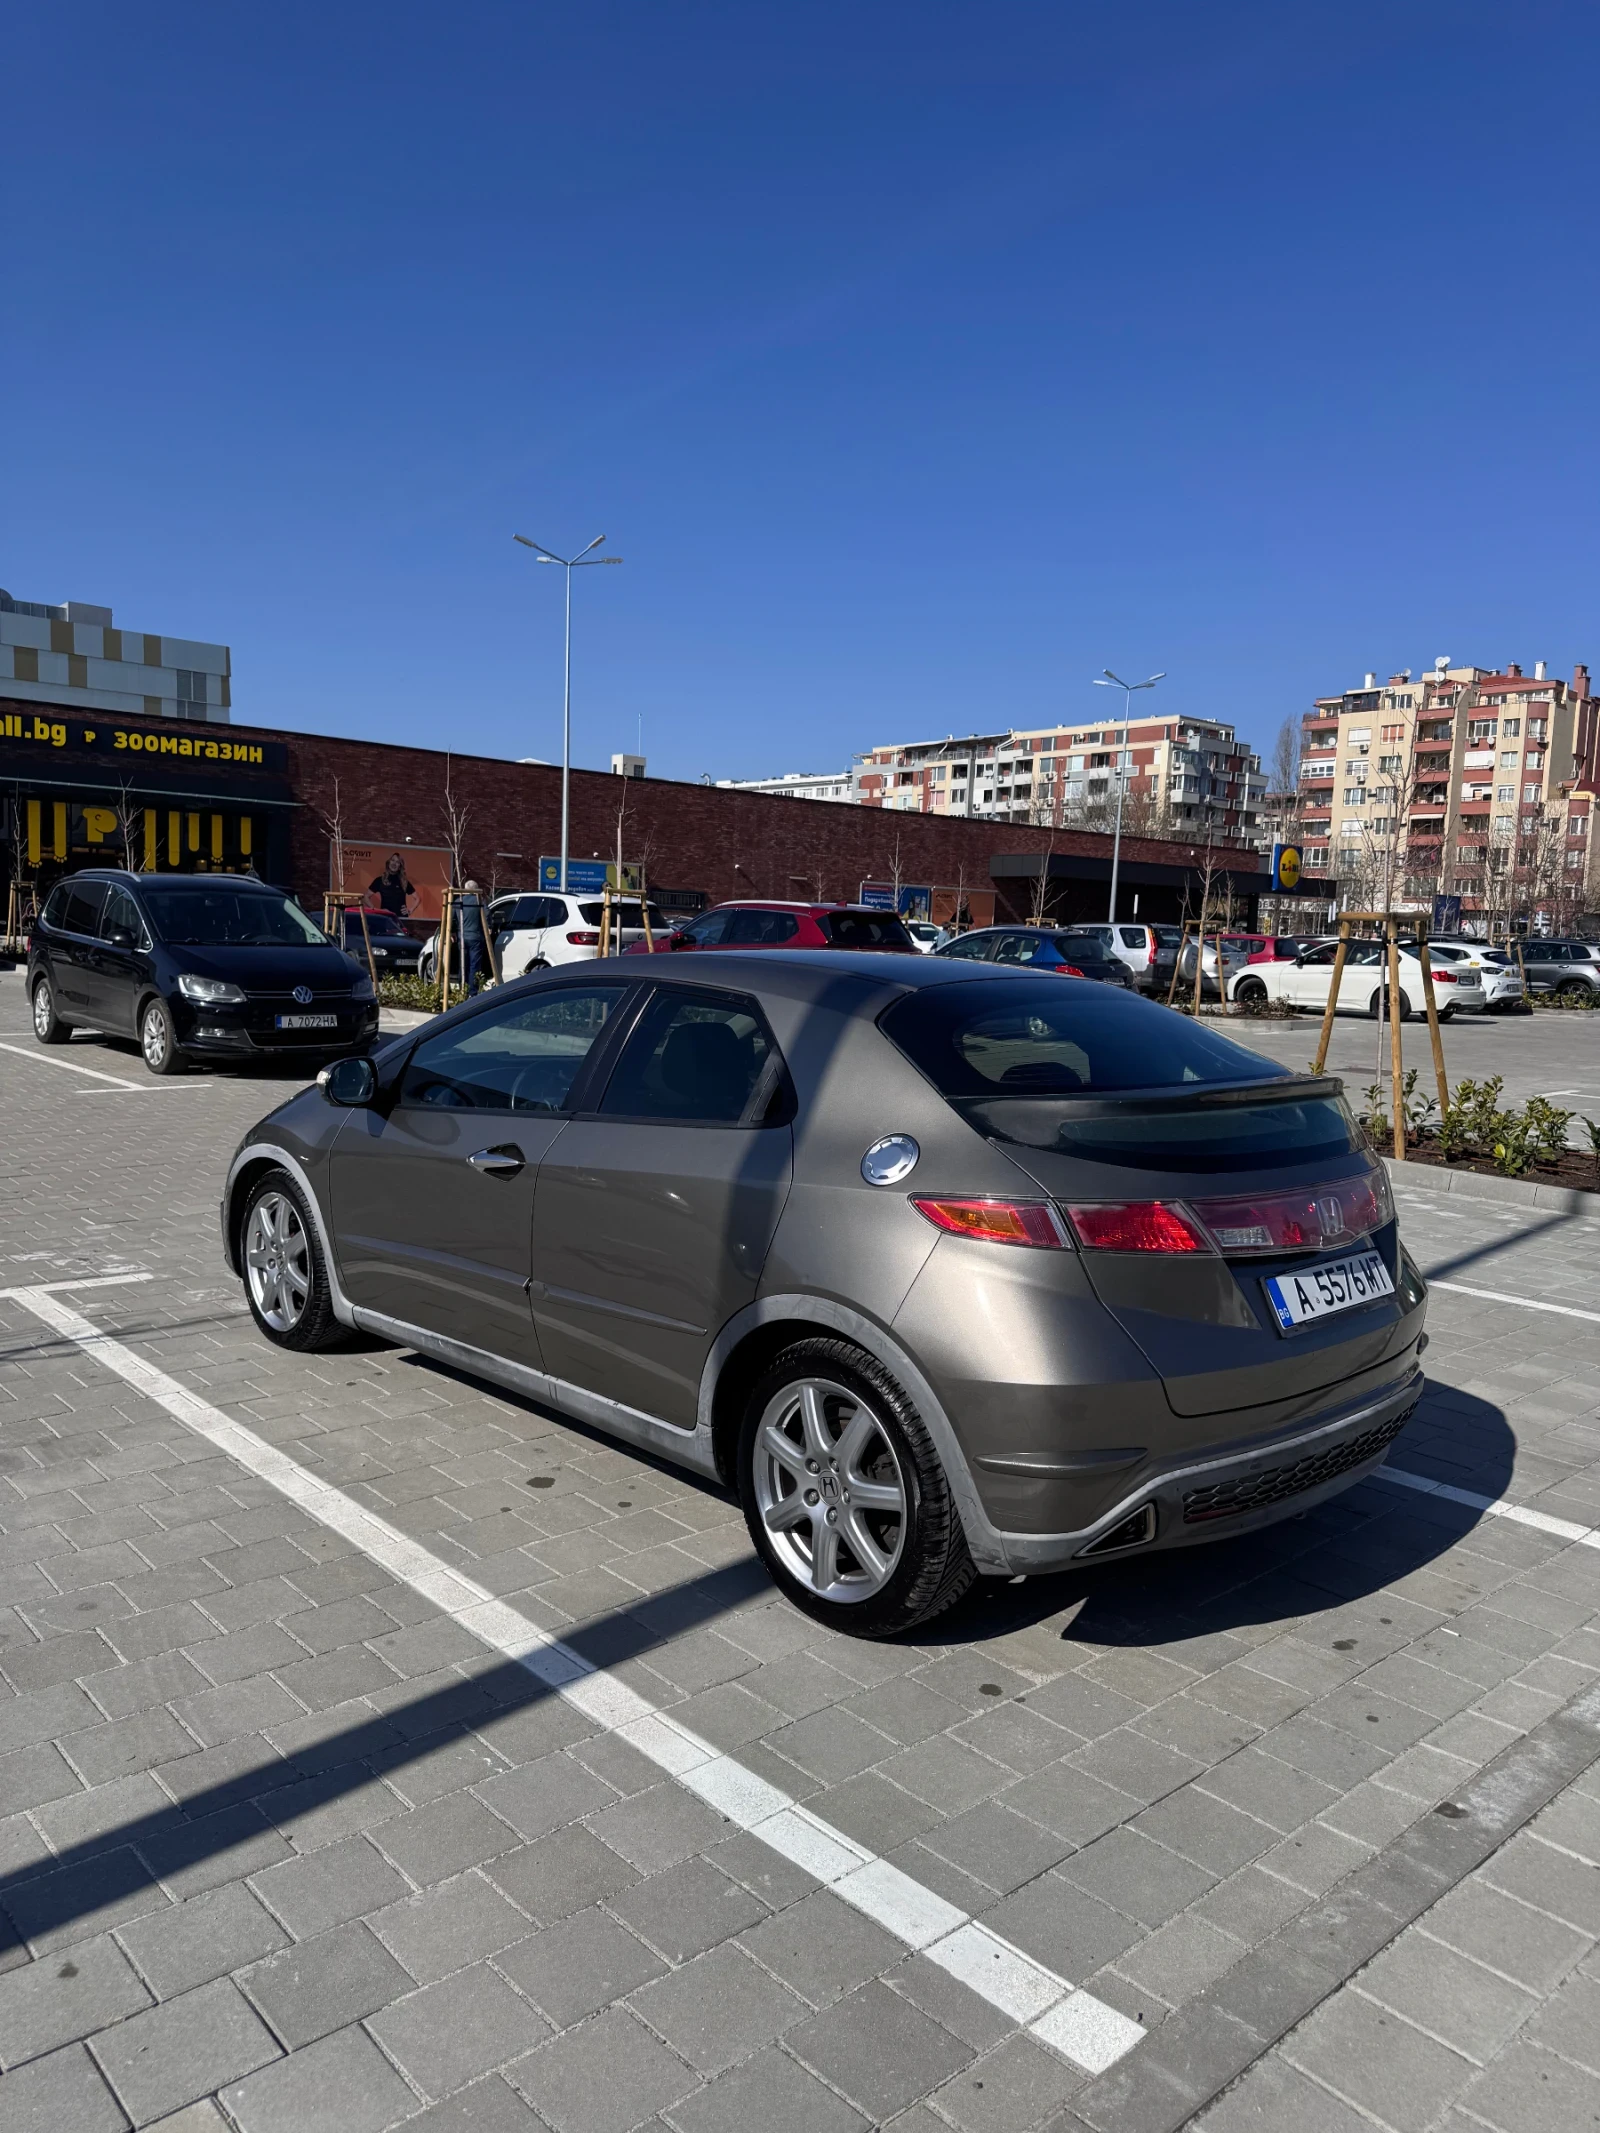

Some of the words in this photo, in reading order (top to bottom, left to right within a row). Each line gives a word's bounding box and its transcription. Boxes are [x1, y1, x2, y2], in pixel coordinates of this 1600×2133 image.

[0, 715, 67, 747] ll.bg
[113, 731, 263, 763] зоомагазин
[1278, 1308, 1291, 1320] BG
